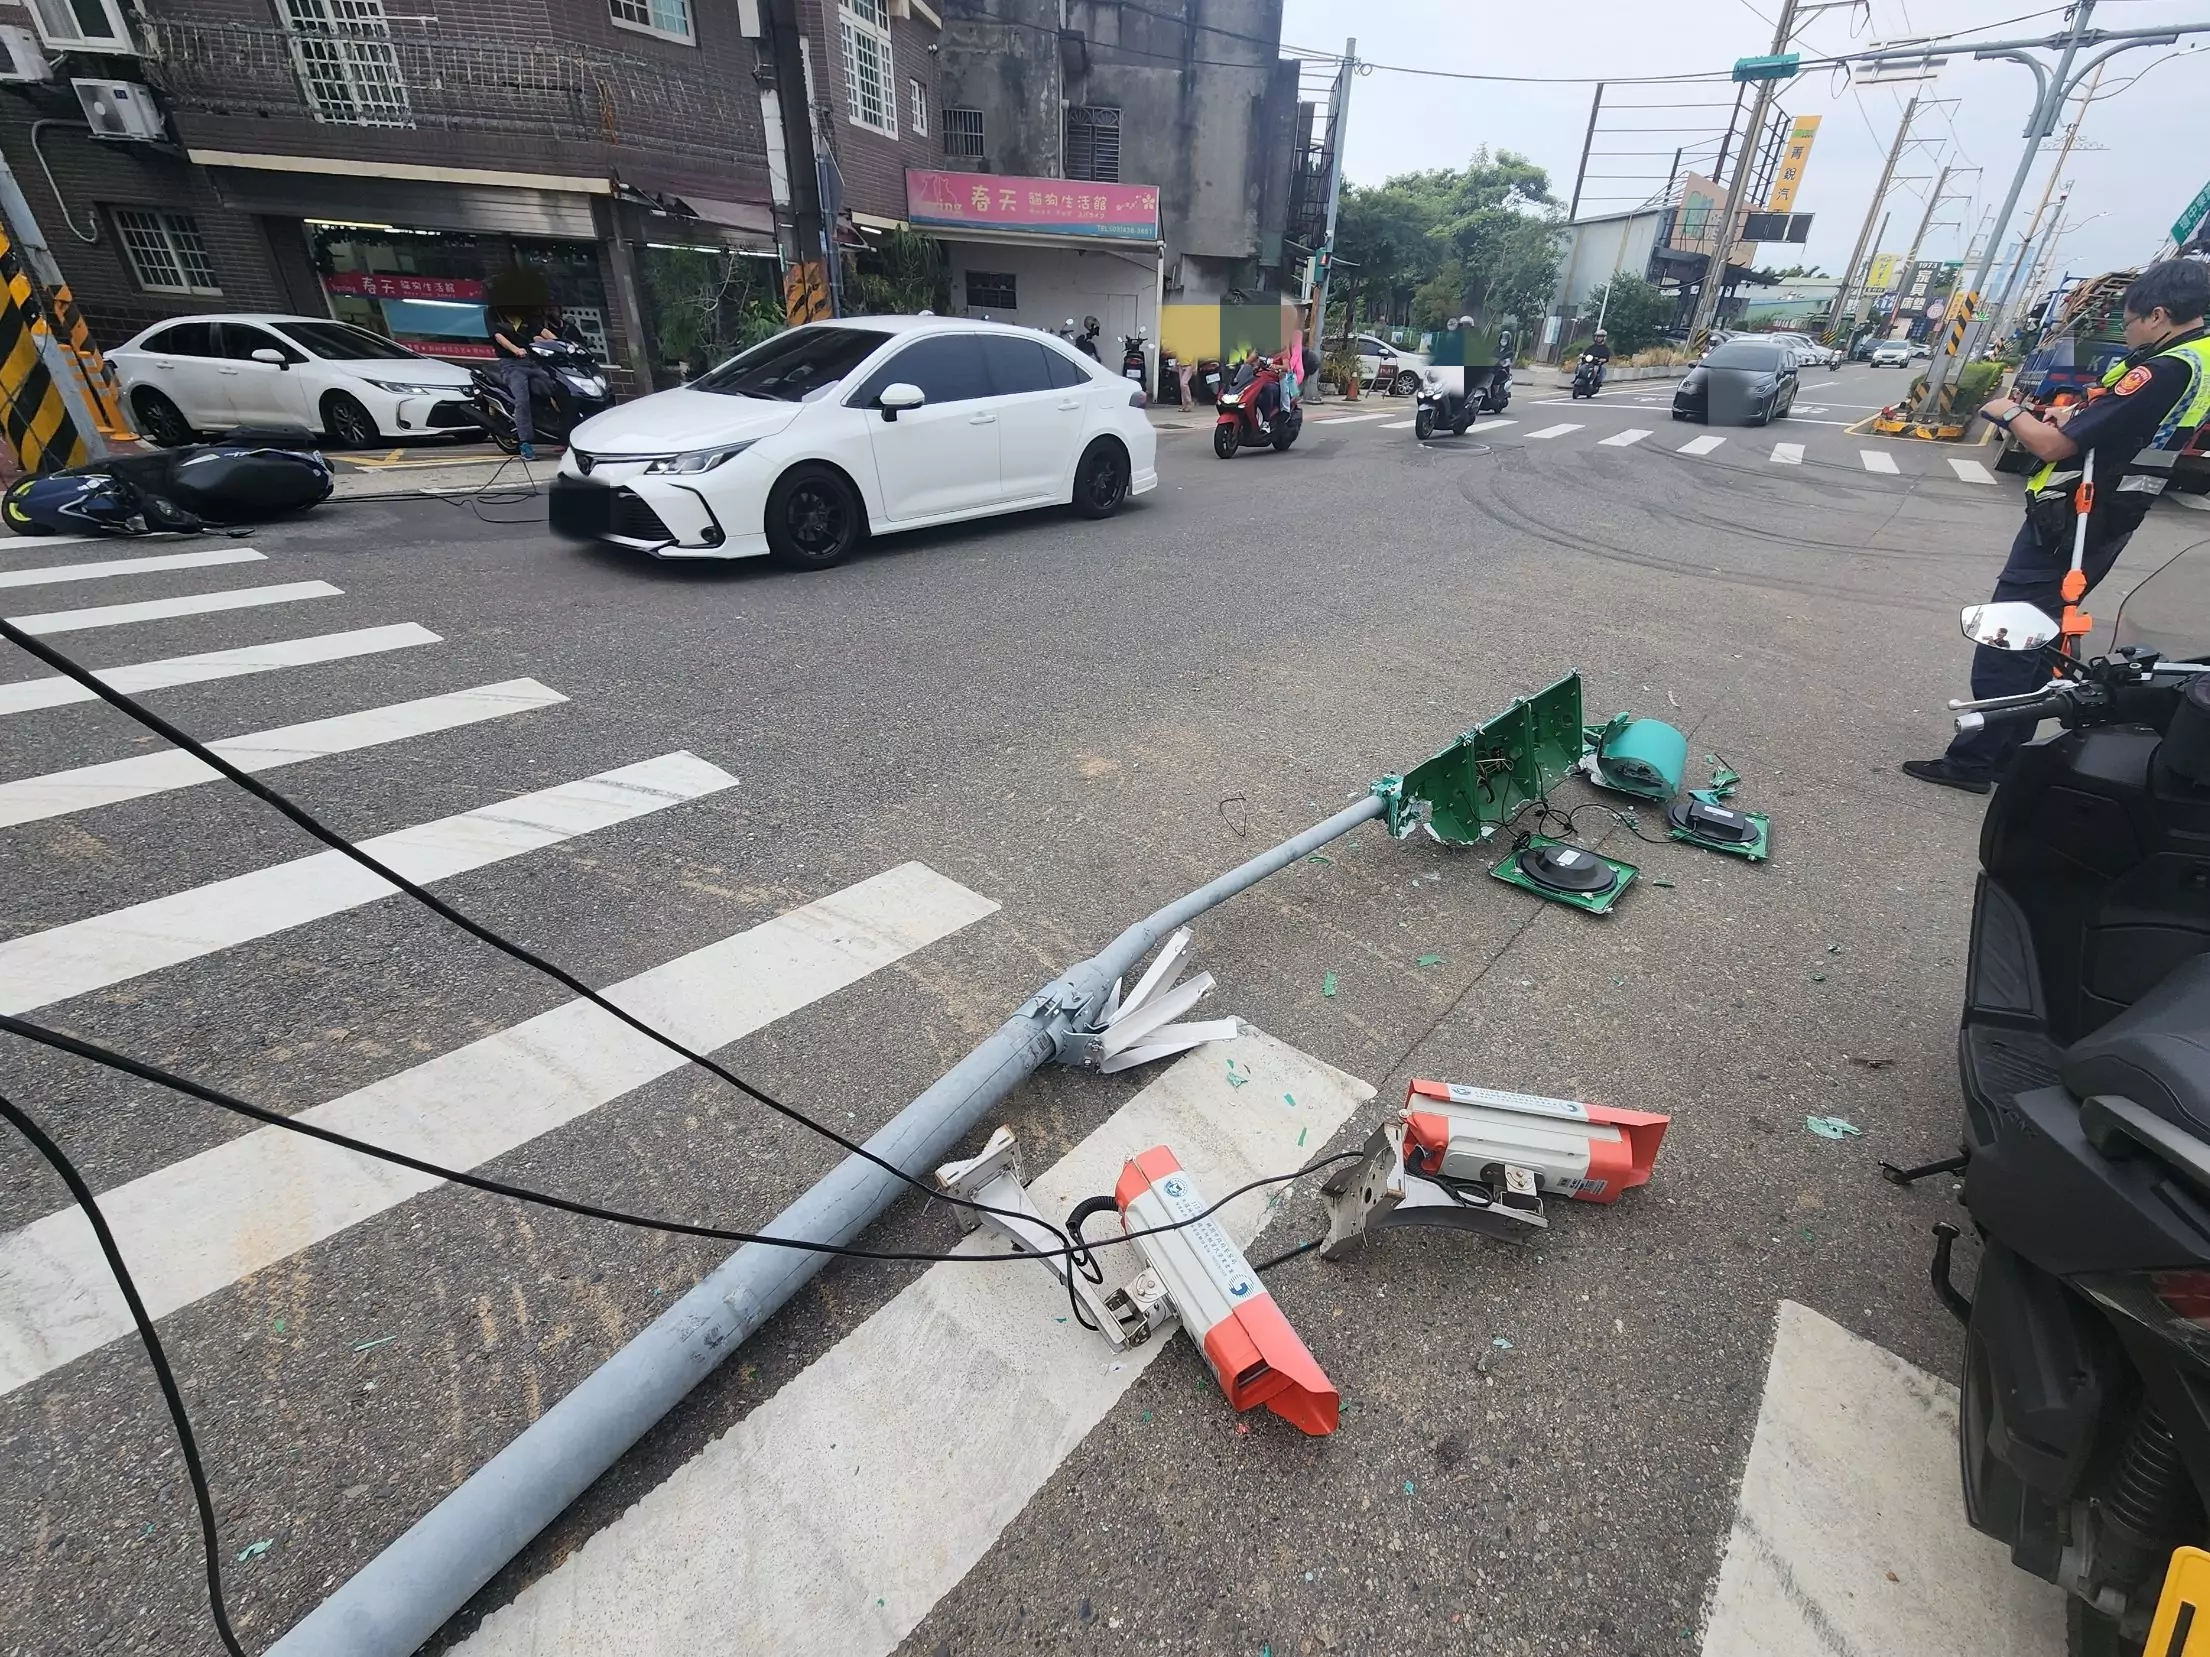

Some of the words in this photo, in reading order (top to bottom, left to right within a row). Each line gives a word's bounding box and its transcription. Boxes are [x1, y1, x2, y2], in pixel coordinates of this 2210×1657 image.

[971, 185, 1017, 212] 春天
[1918, 261, 1938, 269] 1973
[361, 276, 395, 295] 春天
